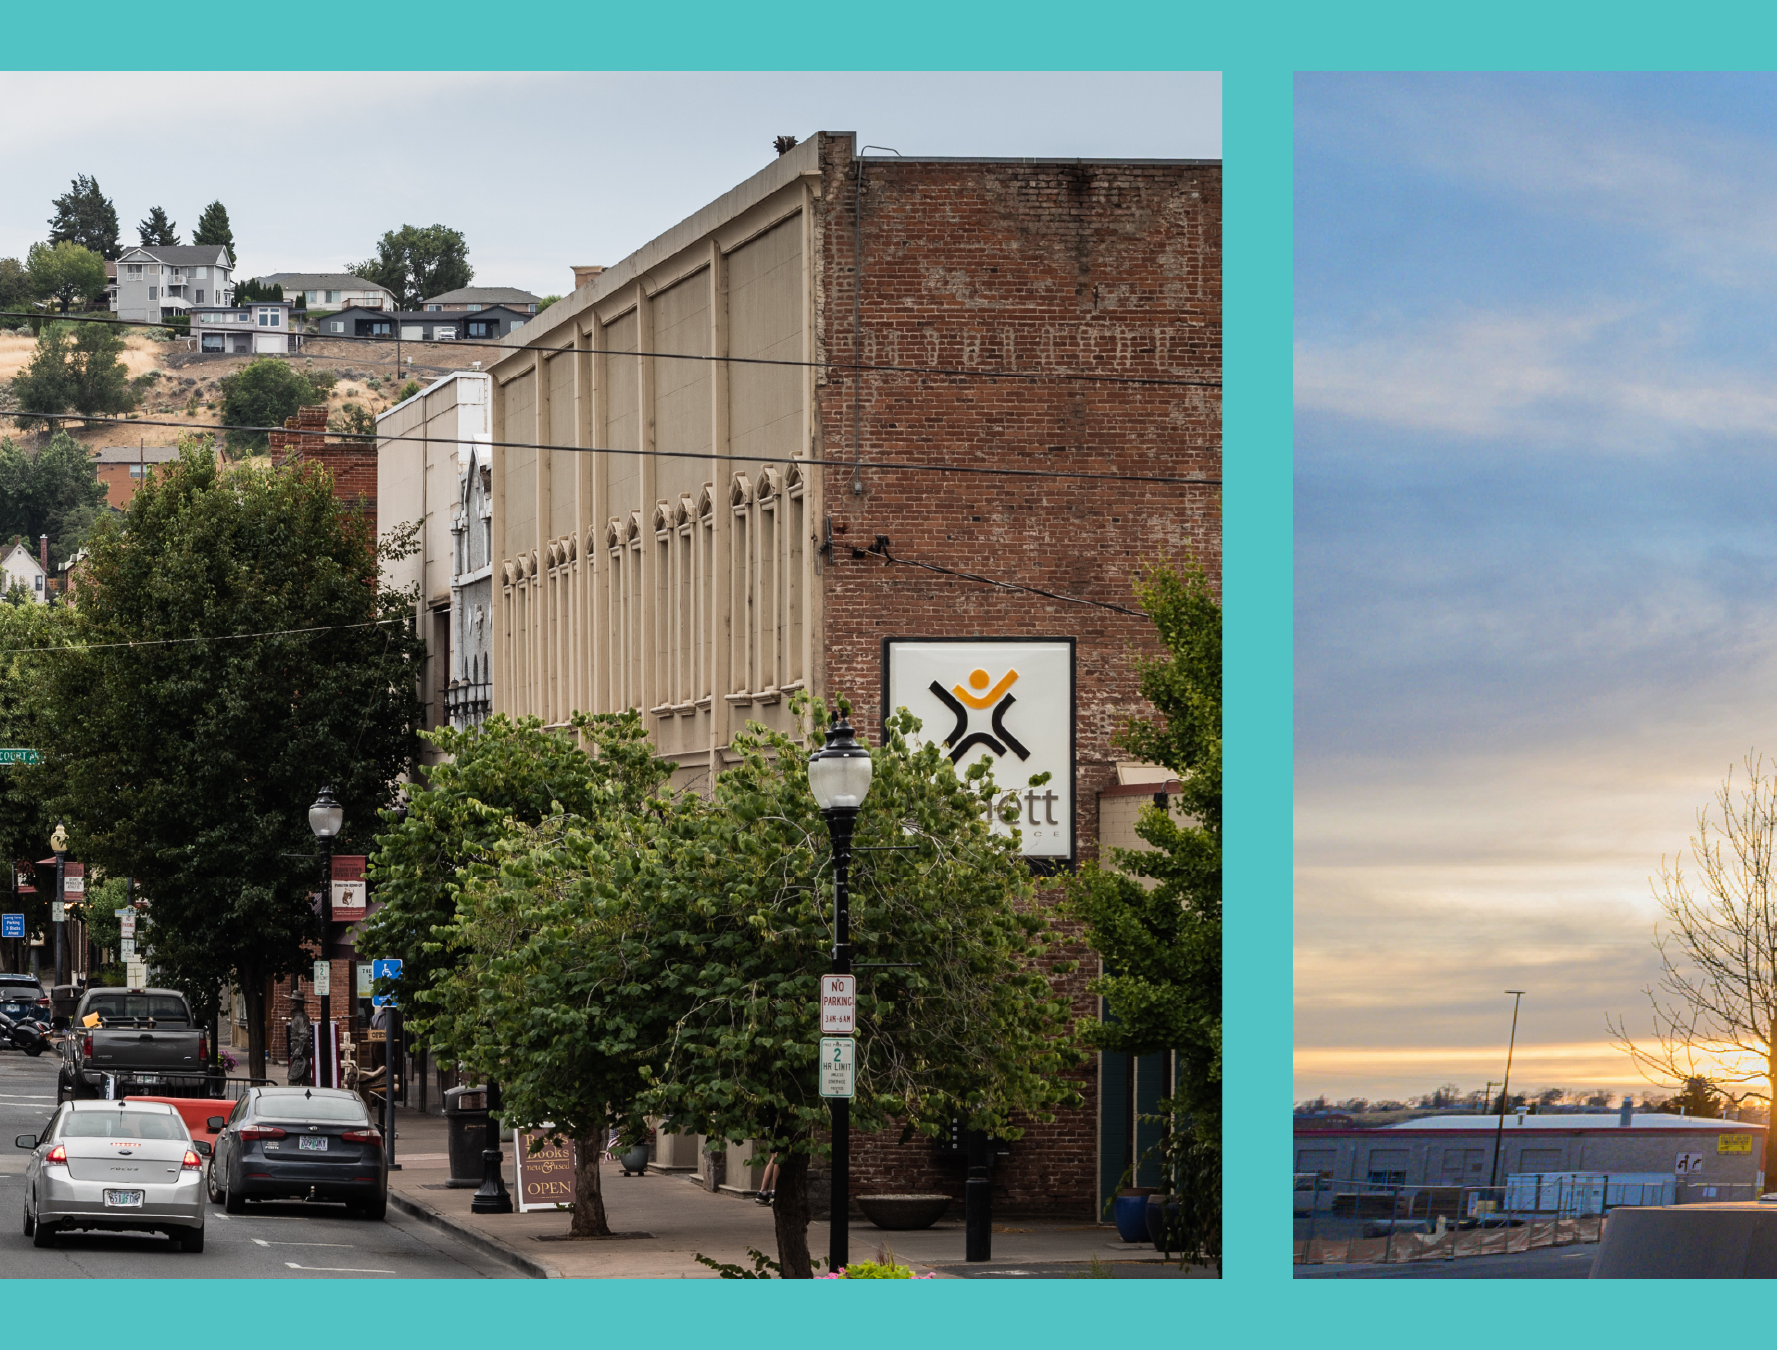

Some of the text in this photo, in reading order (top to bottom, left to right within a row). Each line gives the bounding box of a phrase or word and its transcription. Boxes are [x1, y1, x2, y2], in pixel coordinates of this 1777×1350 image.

[832, 982, 844, 992] NO
[824, 997, 852, 1006] PARKING
[834, 1048, 841, 1062] 2
[834, 1063, 851, 1071] LIMIT
[527, 1181, 571, 1195] OPEN
